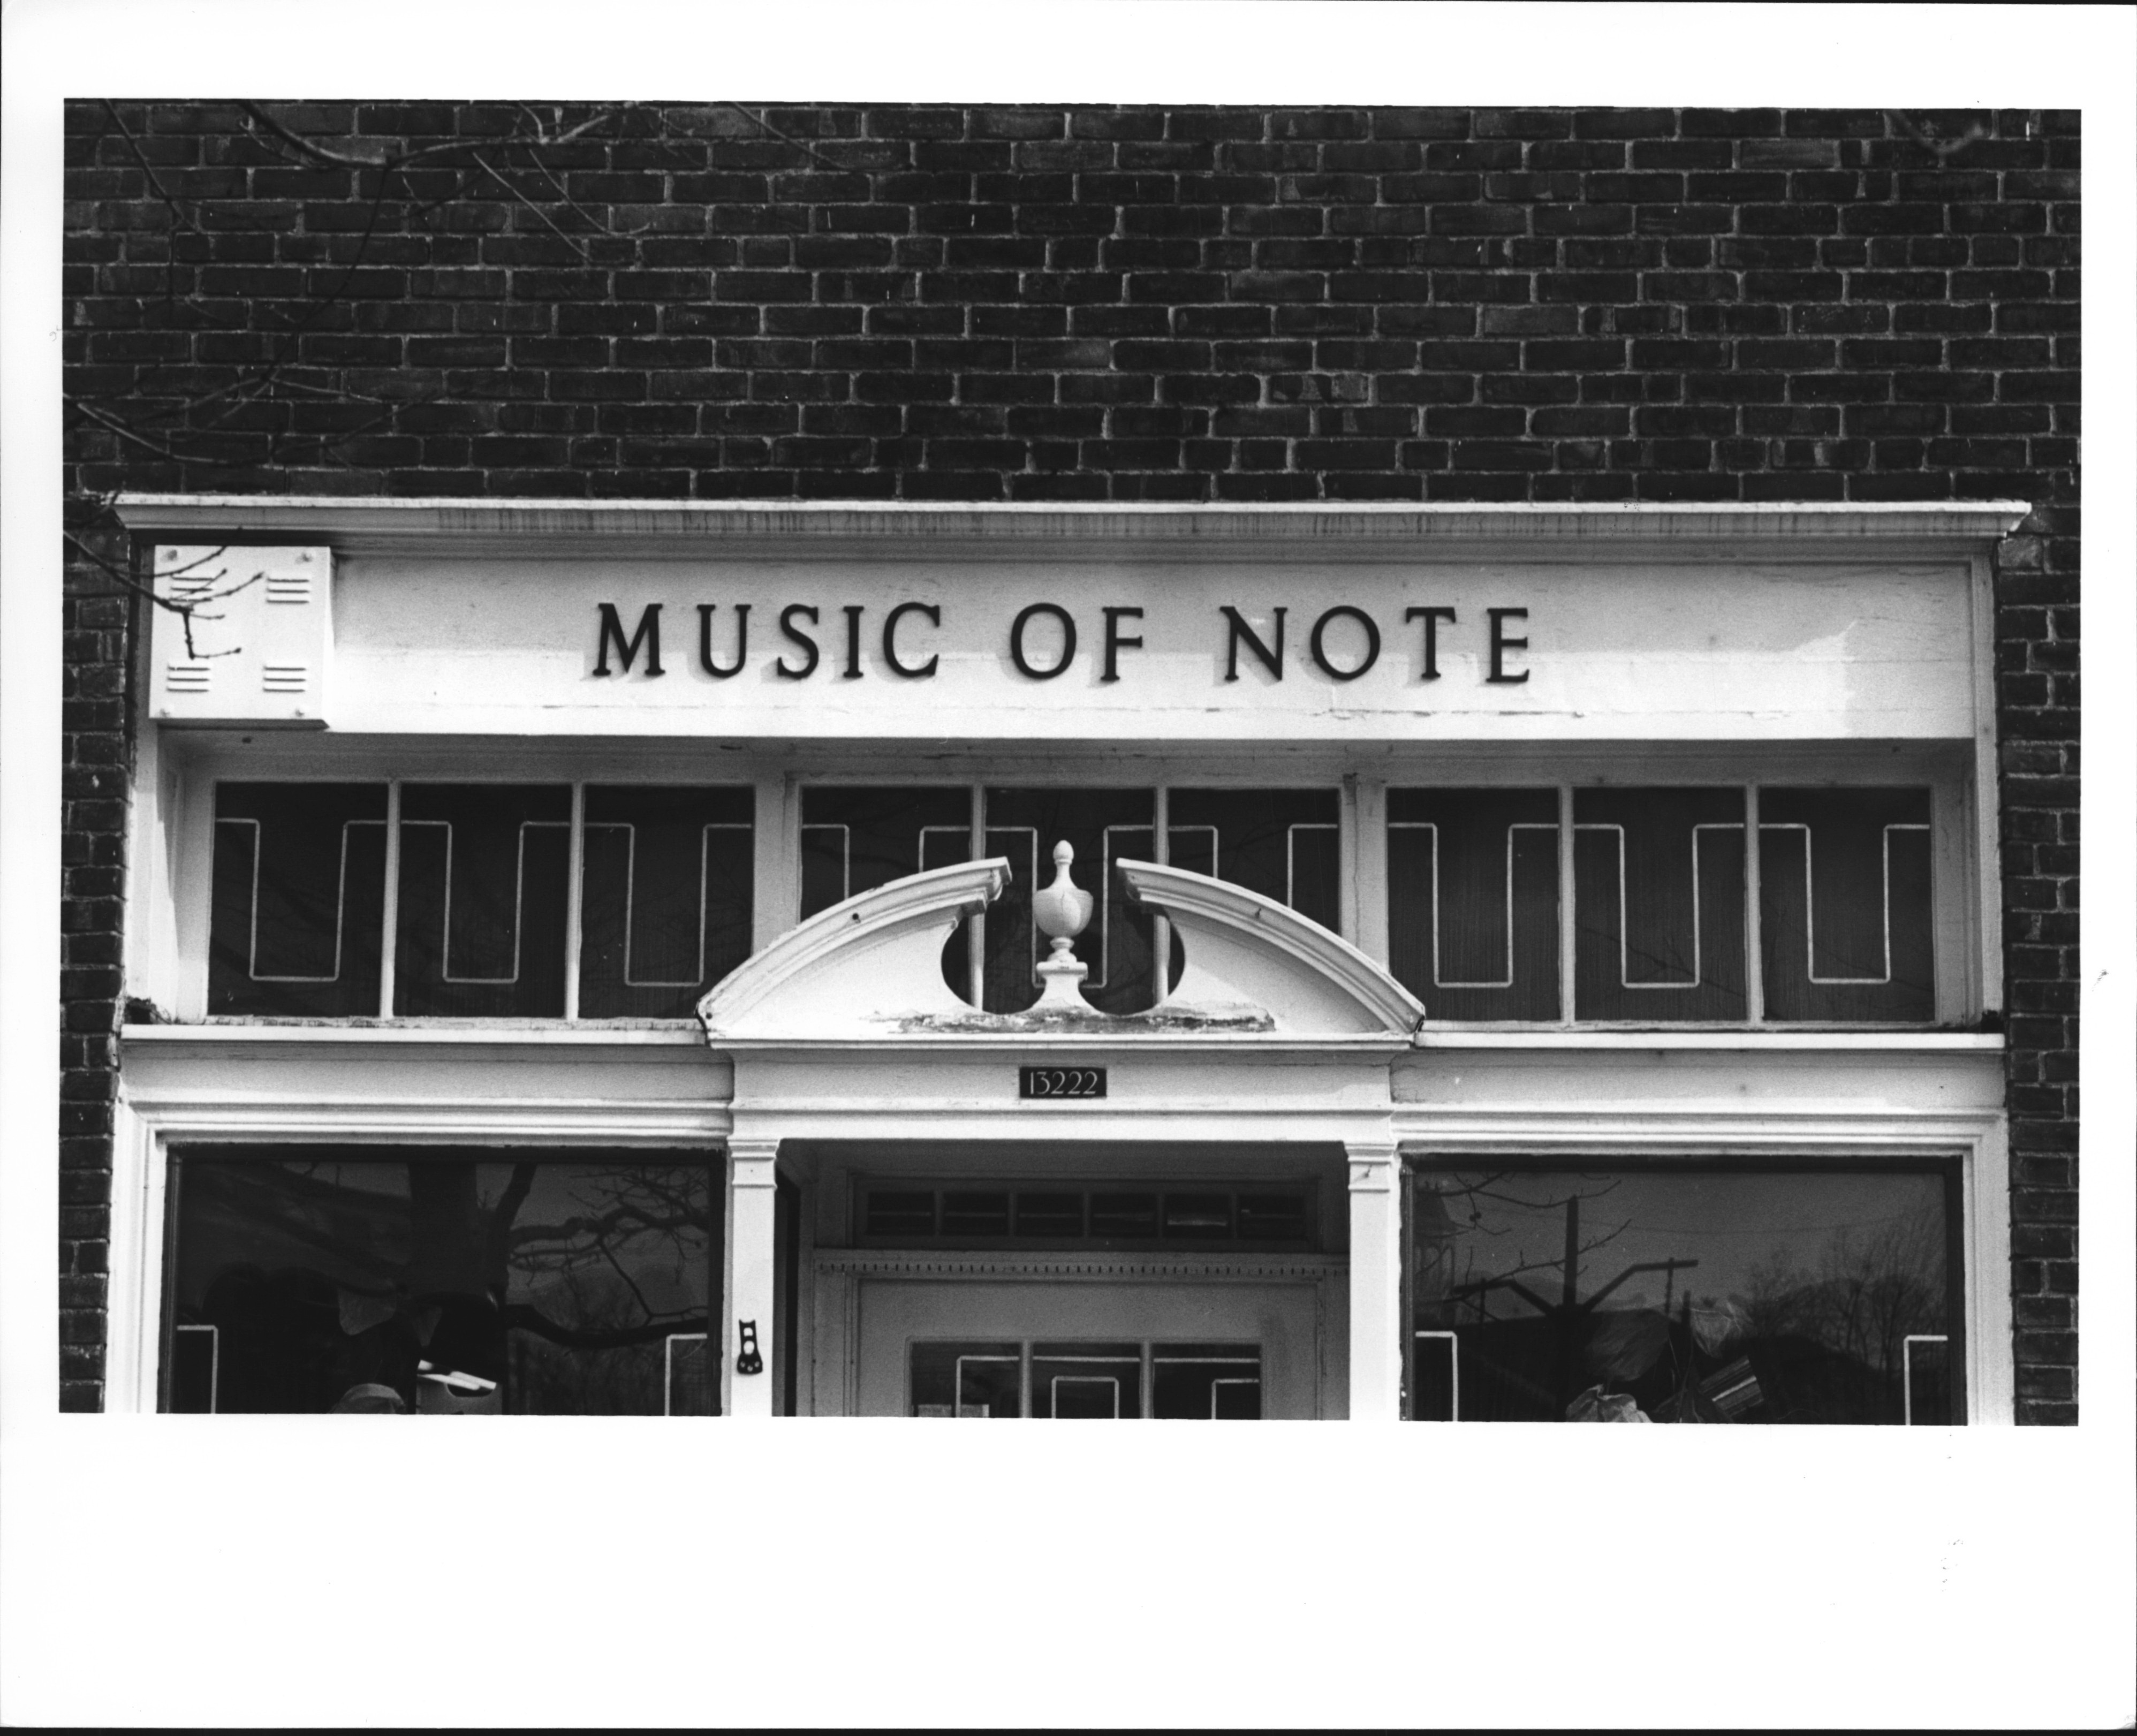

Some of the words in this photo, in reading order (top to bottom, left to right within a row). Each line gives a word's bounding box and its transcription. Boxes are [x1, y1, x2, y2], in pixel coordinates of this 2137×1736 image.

[592, 601, 941, 681] MUSIC
[1010, 602, 1144, 683] OF
[1218, 605, 1530, 684] NOTE
[1029, 1071, 1098, 1095] 13222
